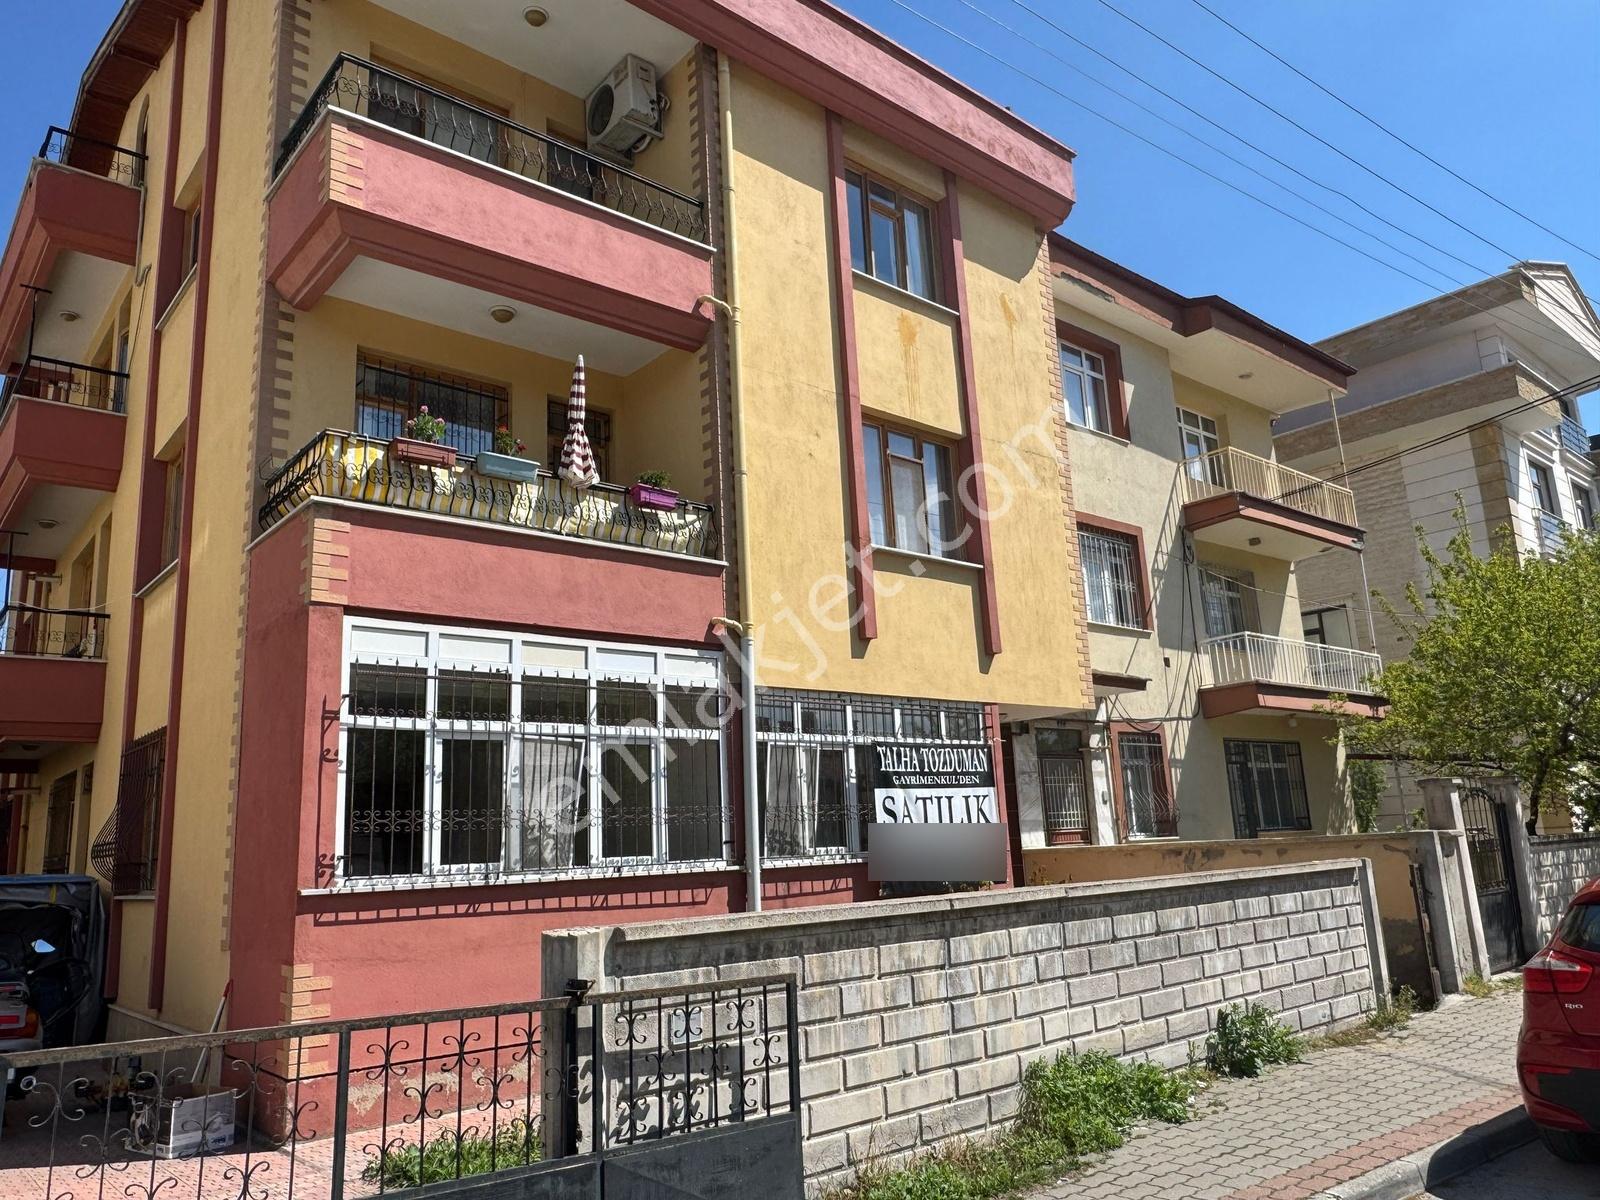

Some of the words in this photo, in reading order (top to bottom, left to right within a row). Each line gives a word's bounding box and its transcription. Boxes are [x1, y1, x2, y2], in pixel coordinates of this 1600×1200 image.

[876, 745, 920, 772] TALHA
[919, 747, 988, 772] TOZDUMAN
[882, 795, 992, 823] SATILIK
